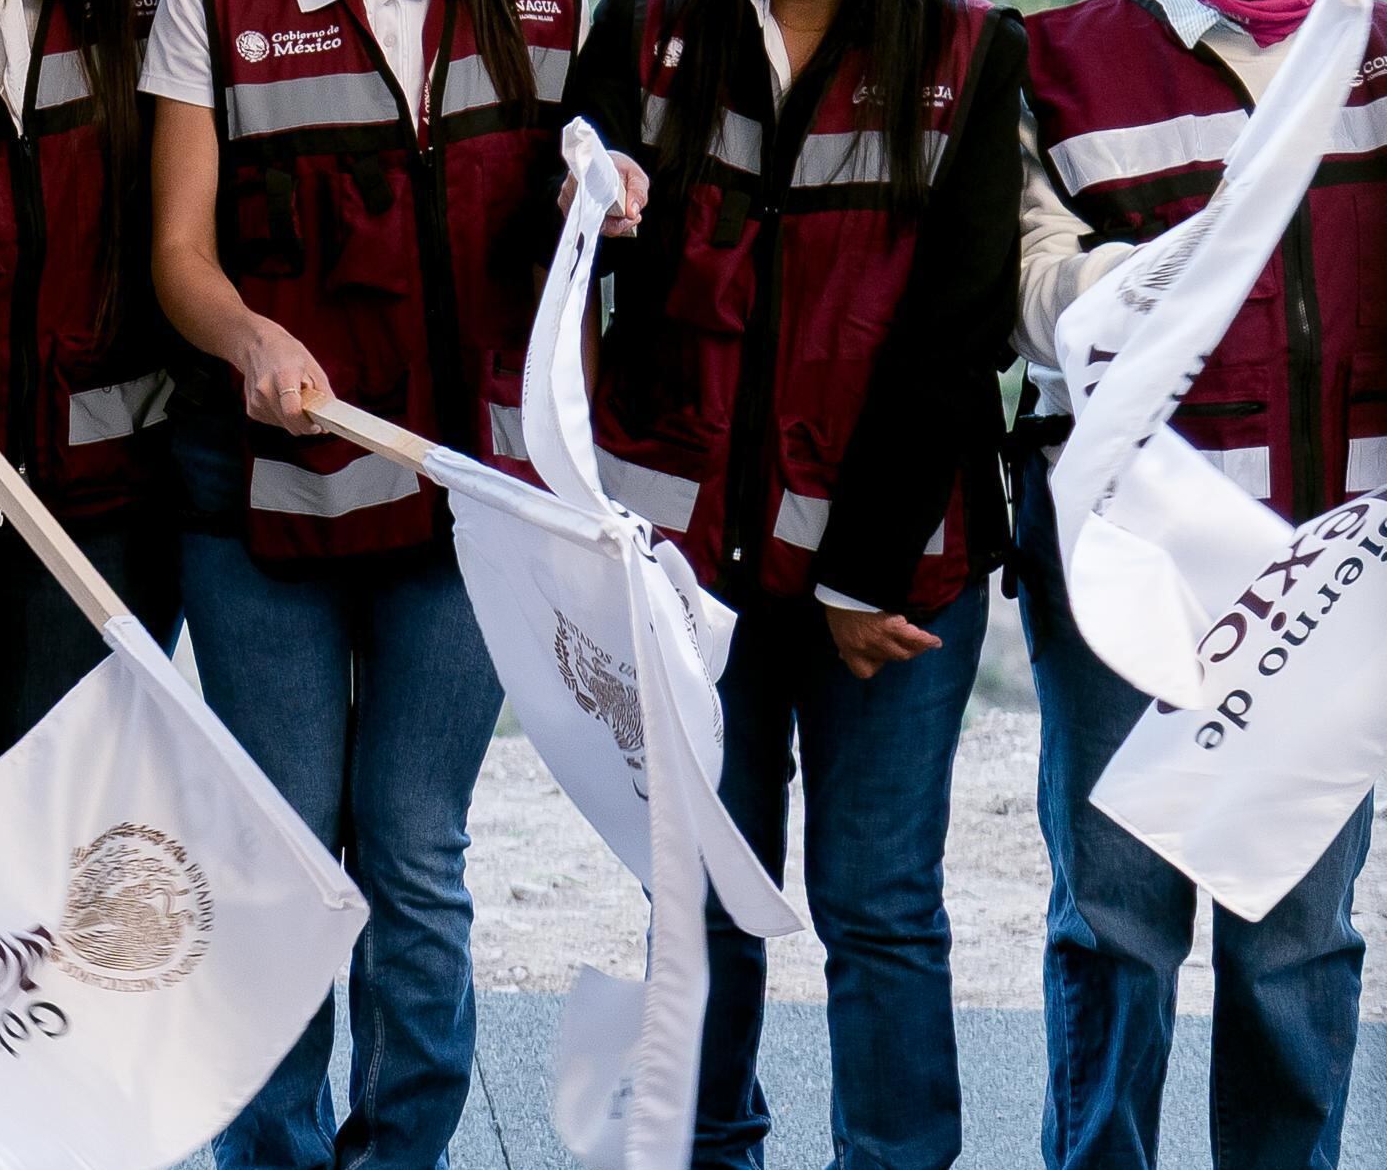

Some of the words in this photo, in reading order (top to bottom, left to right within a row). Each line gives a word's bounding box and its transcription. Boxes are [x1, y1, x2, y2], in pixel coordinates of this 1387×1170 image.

[272, 30, 325, 43] Gobierno
[326, 24, 340, 36] de
[272, 37, 342, 58] México
[1187, 498, 1379, 686] éxic
[1195, 688, 1253, 751] de
